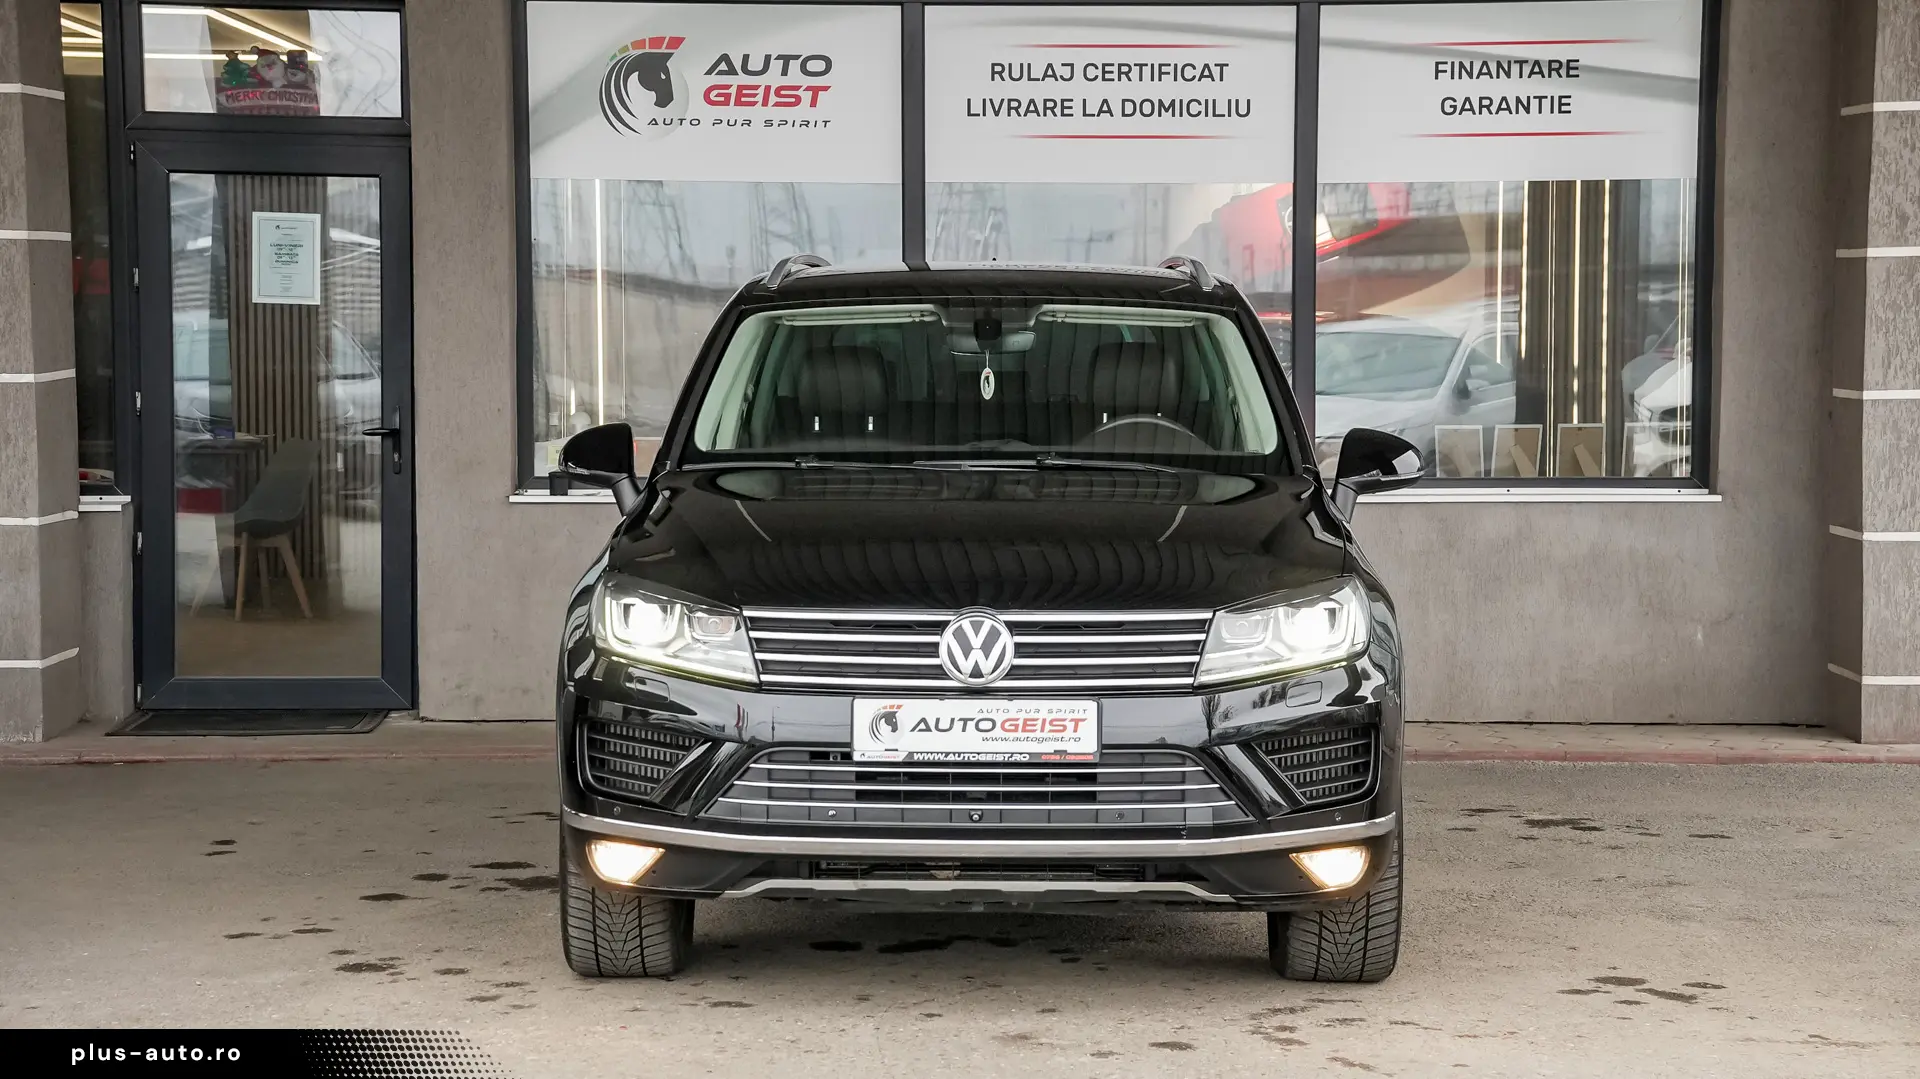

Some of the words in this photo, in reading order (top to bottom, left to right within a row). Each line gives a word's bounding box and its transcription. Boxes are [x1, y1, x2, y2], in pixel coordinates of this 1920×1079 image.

[703, 53, 833, 77] AUTO
[990, 63, 1075, 82] RULAJ
[1082, 63, 1229, 82] CERTIFICAT
[1434, 59, 1580, 80] FINANTARE
[225, 91, 264, 104] MERRY
[703, 84, 832, 108] GEIST
[1440, 95, 1572, 116] GARANTIE
[966, 98, 1074, 117] LIVRARE
[1081, 98, 1114, 117] LA
[1120, 98, 1251, 118] DOMICILIU
[647, 117, 701, 127] AUTO
[712, 118, 752, 128] PUR
[763, 119, 832, 129] SPIRIT
[909, 717, 1088, 733] AUTOGEIST
[981, 735, 1081, 744] www.autogeist.ro
[913, 753, 1030, 761] WWW.AUTOGEIST.RO
